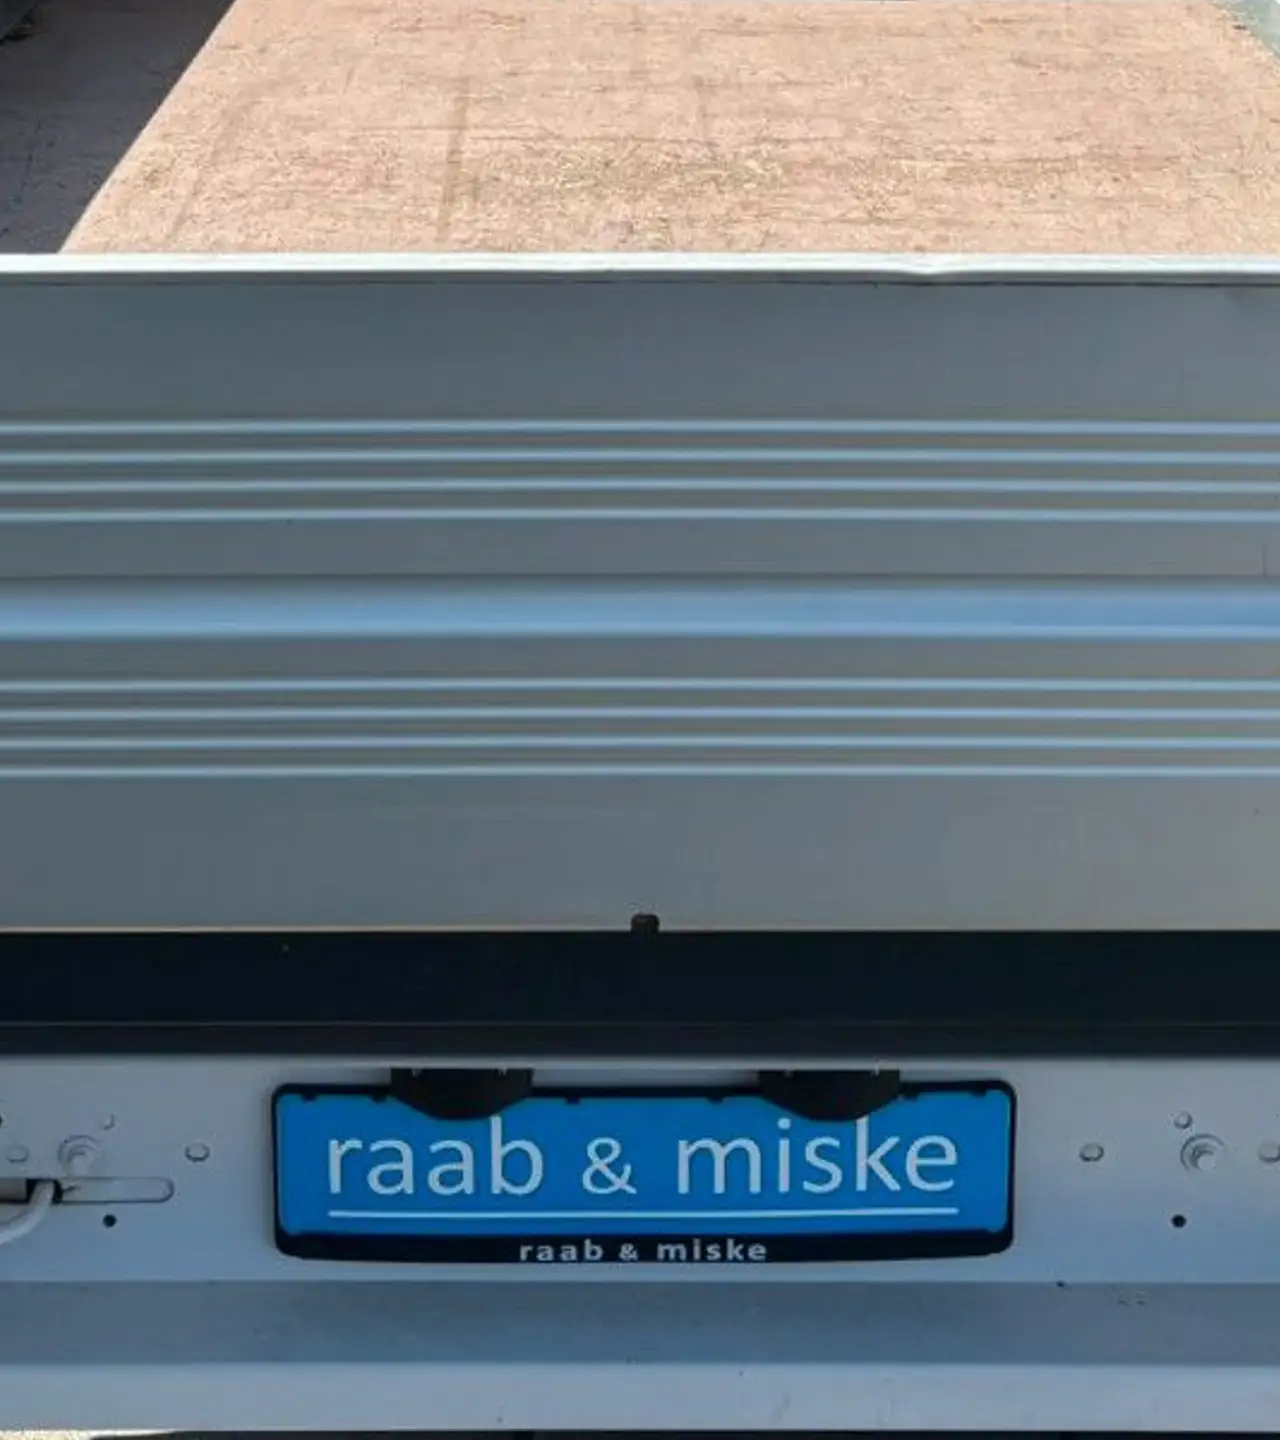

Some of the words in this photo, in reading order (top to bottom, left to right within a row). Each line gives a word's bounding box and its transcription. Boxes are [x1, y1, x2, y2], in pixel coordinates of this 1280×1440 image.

[328, 1116, 543, 1195] raab
[581, 1137, 637, 1195] &
[676, 1116, 958, 1194] miske
[520, 1237, 604, 1262] raab
[620, 1241, 639, 1262] &
[657, 1237, 767, 1261] miske
